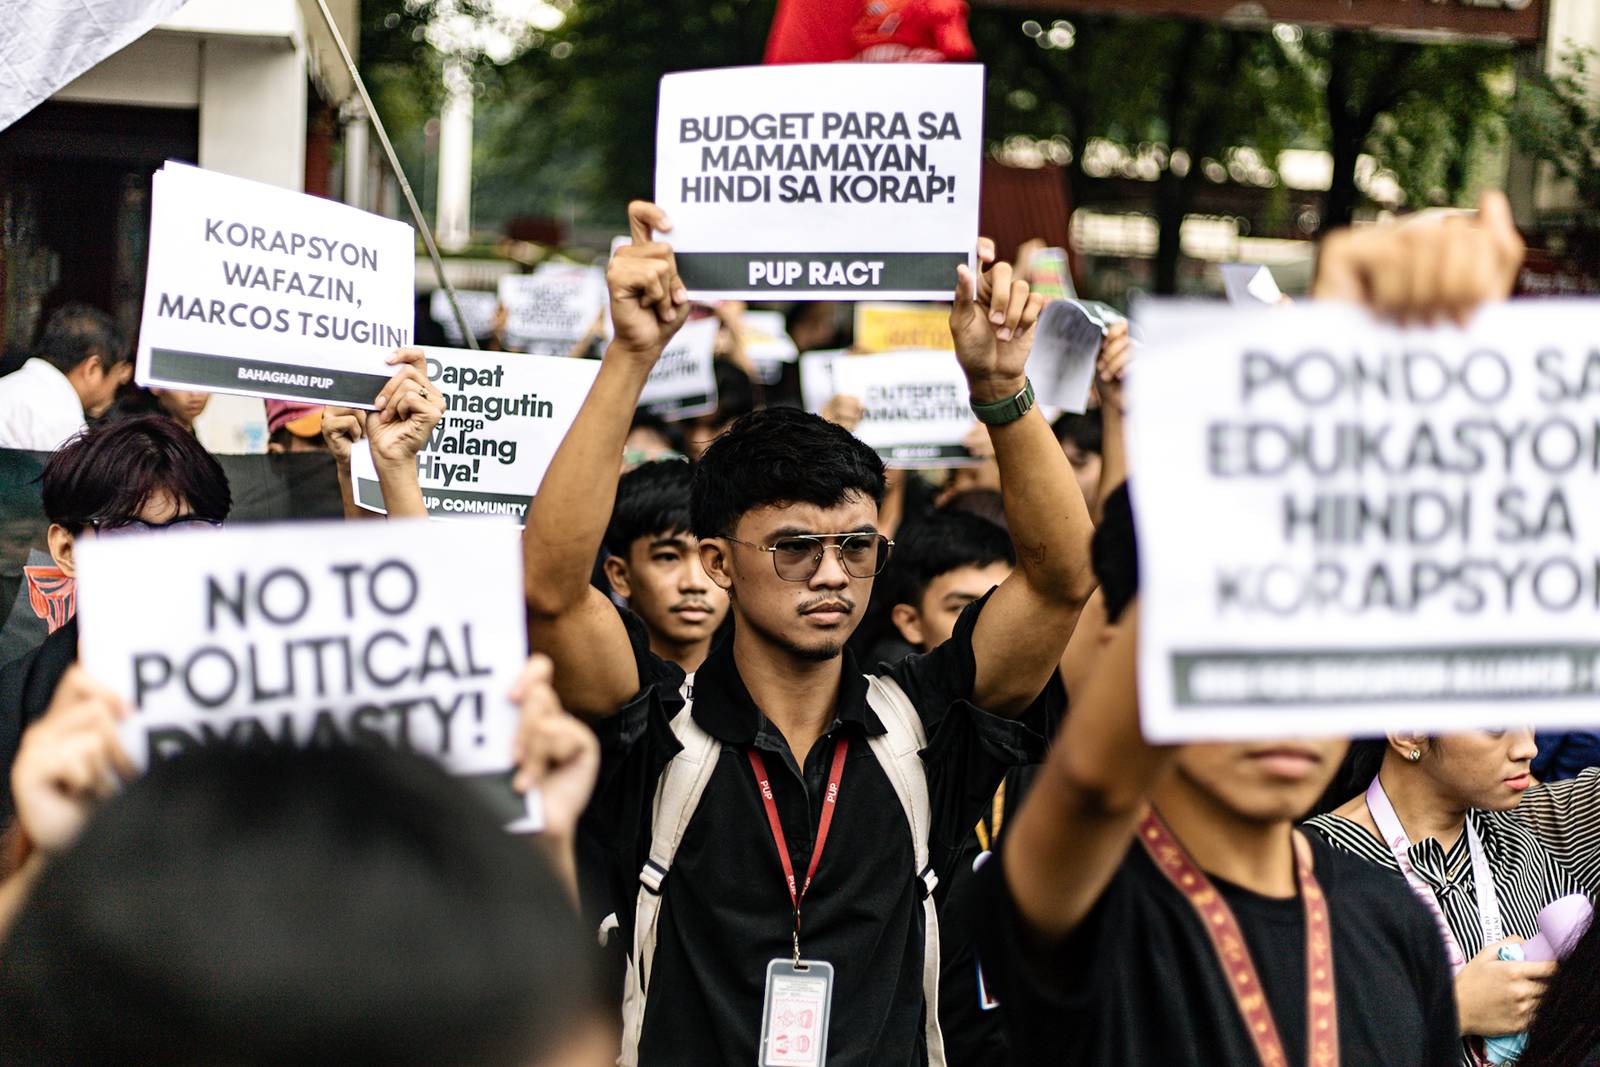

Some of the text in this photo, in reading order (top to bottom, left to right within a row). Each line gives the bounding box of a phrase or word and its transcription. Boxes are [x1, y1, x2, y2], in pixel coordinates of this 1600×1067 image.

[679, 111, 961, 143] BUDGET PARA SA
[701, 144, 936, 178] MAMAMAYAN,
[681, 174, 956, 203] HINDI SA KORAP!
[205, 218, 377, 271] KORAPSYON
[223, 261, 362, 309] WAFAZIN,
[748, 261, 884, 285] PUP RACT
[158, 292, 408, 349] MARCOS TSUGIIN!
[237, 367, 334, 389] BAHAGHARI PUP
[425, 358, 504, 391] Dapat
[1241, 351, 1513, 407] PONDO
[450, 417, 483, 432] mga
[421, 429, 517, 465] Walang
[1207, 417, 1600, 478] EDUKASYO
[416, 455, 481, 487] Hiya!
[422, 496, 527, 516] UP COMMUNITY
[1281, 486, 1577, 547] HINDI SA
[205, 560, 419, 633] NO TO
[1213, 556, 1600, 617] KORAPSYO
[133, 624, 492, 710] POLITICAL
[761, 780, 772, 800] PUP
[828, 783, 837, 803] PUP
